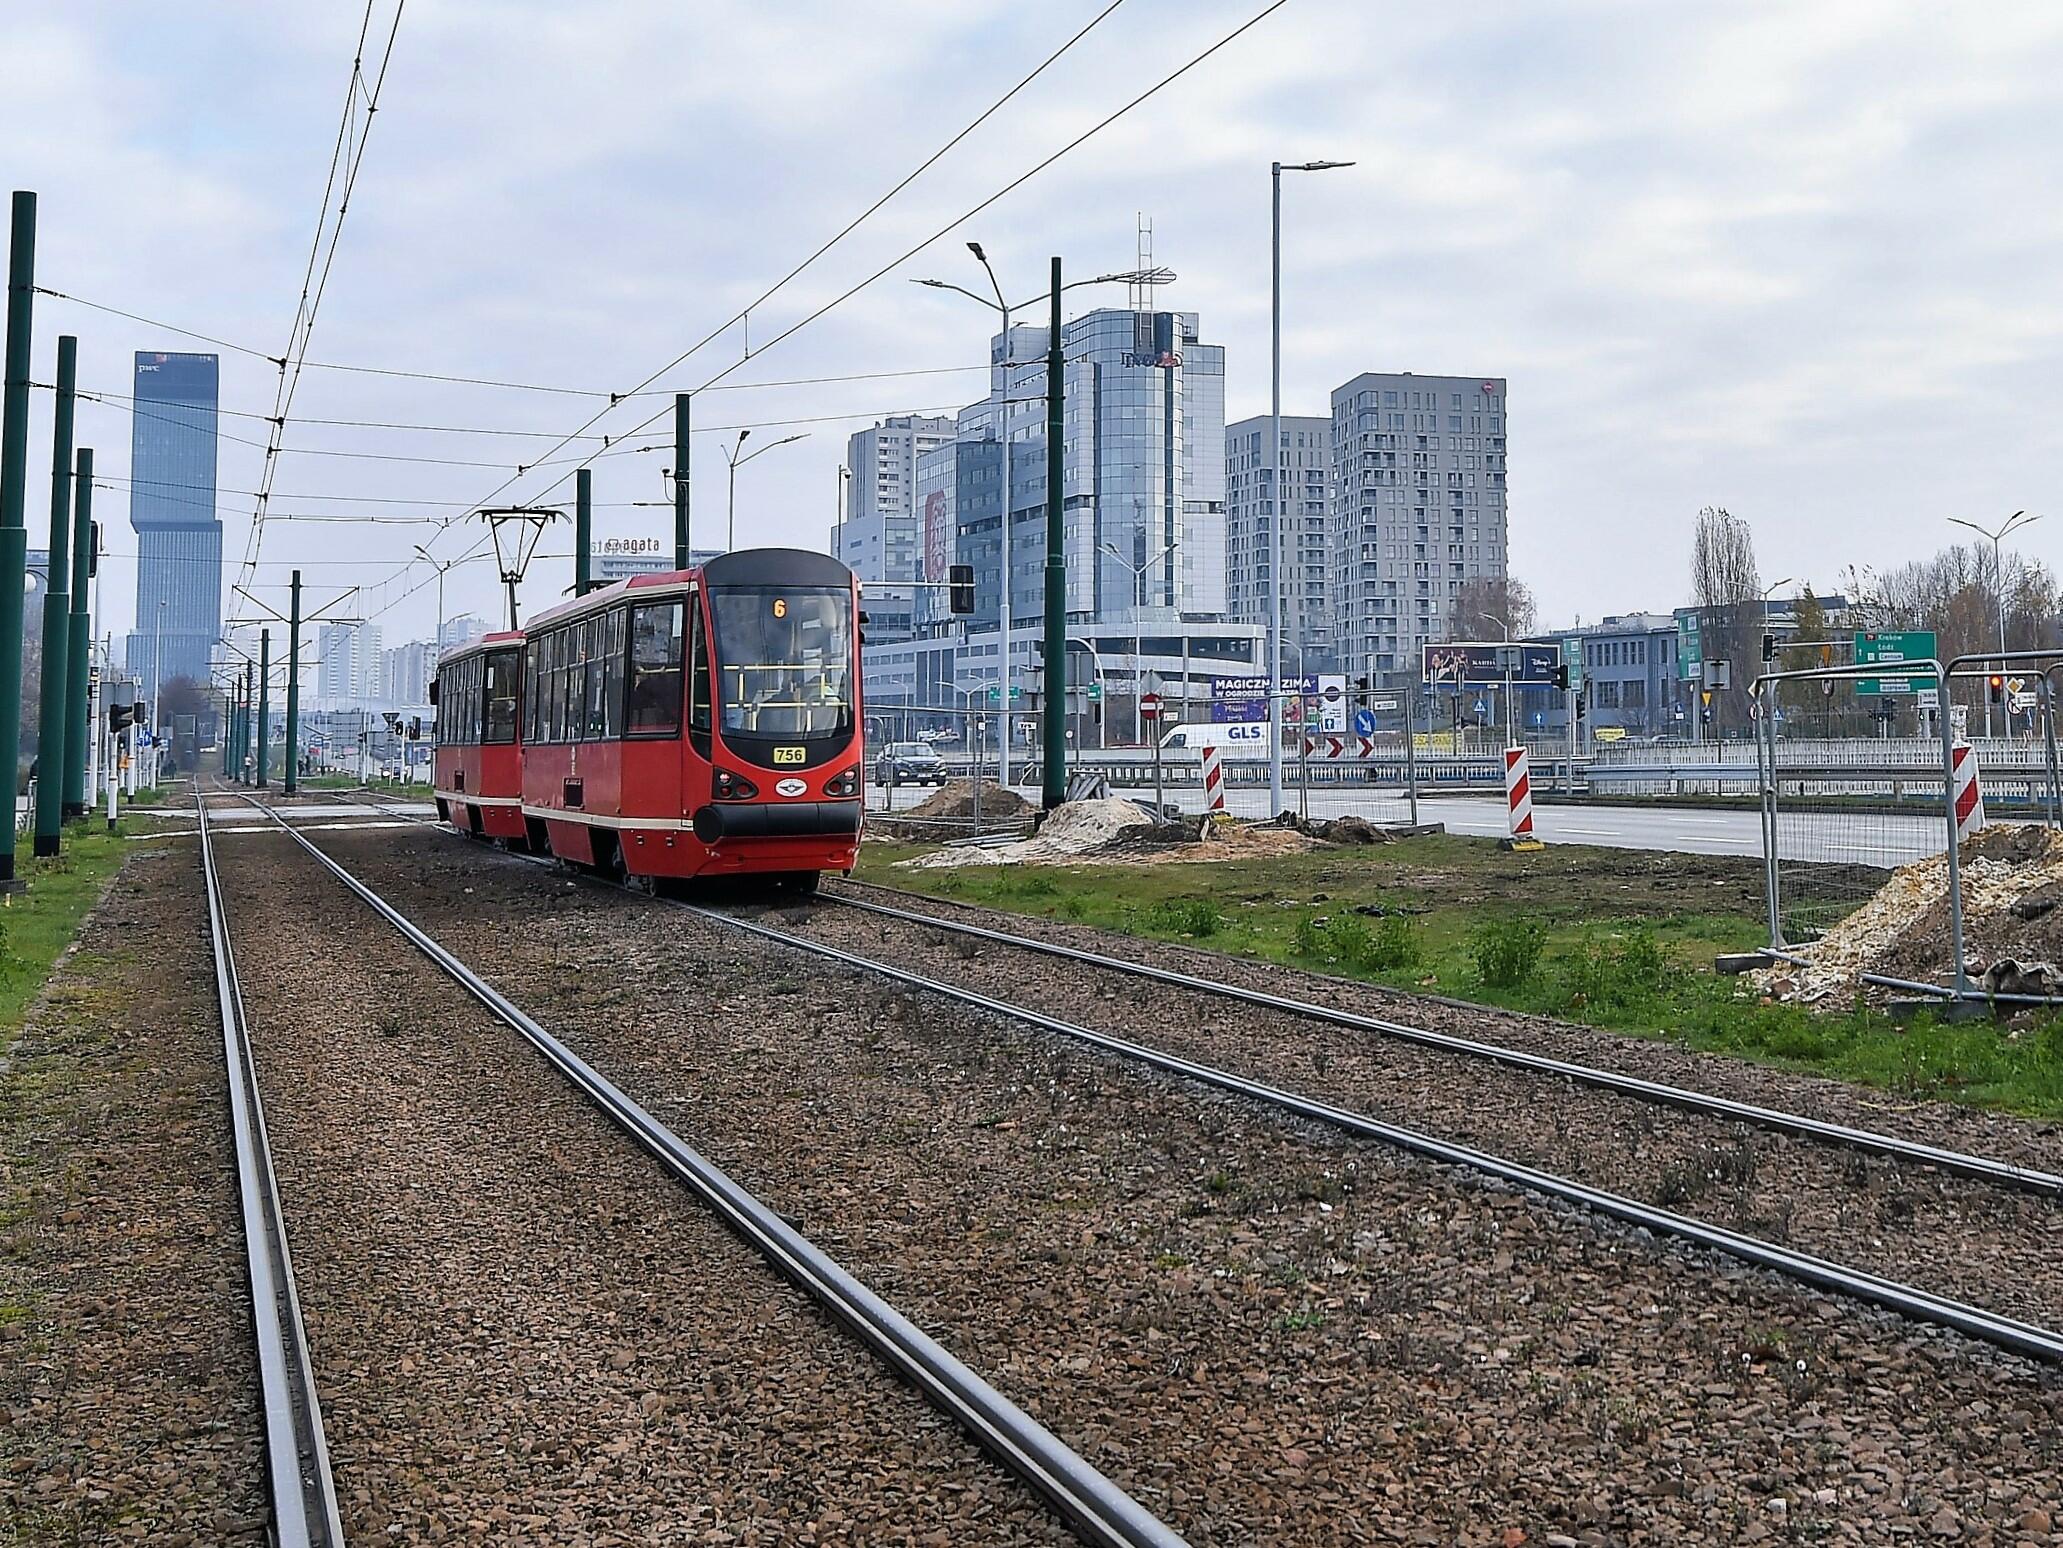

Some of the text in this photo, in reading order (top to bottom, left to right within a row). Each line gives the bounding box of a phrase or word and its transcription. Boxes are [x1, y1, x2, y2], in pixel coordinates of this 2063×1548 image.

[623, 538, 660, 554] agata
[774, 599, 786, 618] 6
[1281, 679, 1312, 689] ZIMA
[1225, 689, 1265, 698] OGRODZIE
[1228, 726, 1261, 739] GLS
[776, 749, 803, 761] 756
